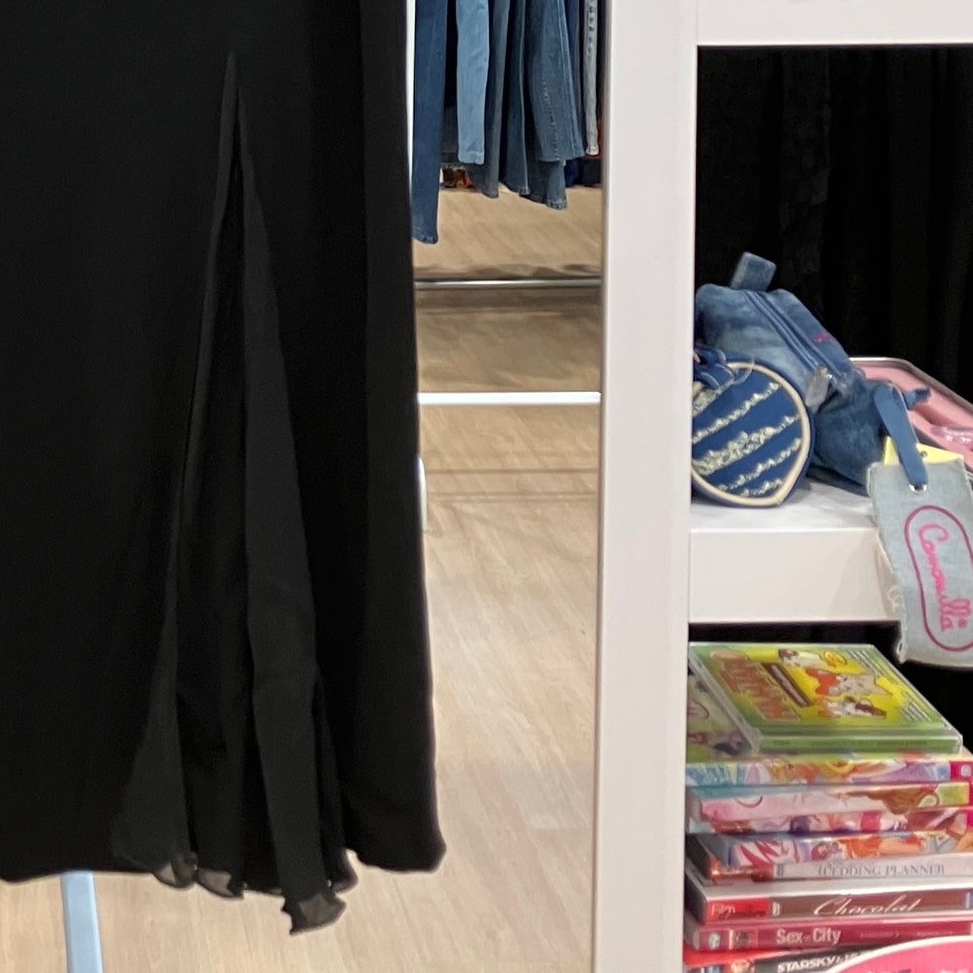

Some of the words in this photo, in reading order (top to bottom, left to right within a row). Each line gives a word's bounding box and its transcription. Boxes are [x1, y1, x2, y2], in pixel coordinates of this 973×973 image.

[884, 863, 945, 877] PLANNER
[813, 894, 922, 916] Chocolat
[776, 928, 803, 944] Sex
[812, 927, 842, 945] City
[776, 955, 836, 973] STARSKY
